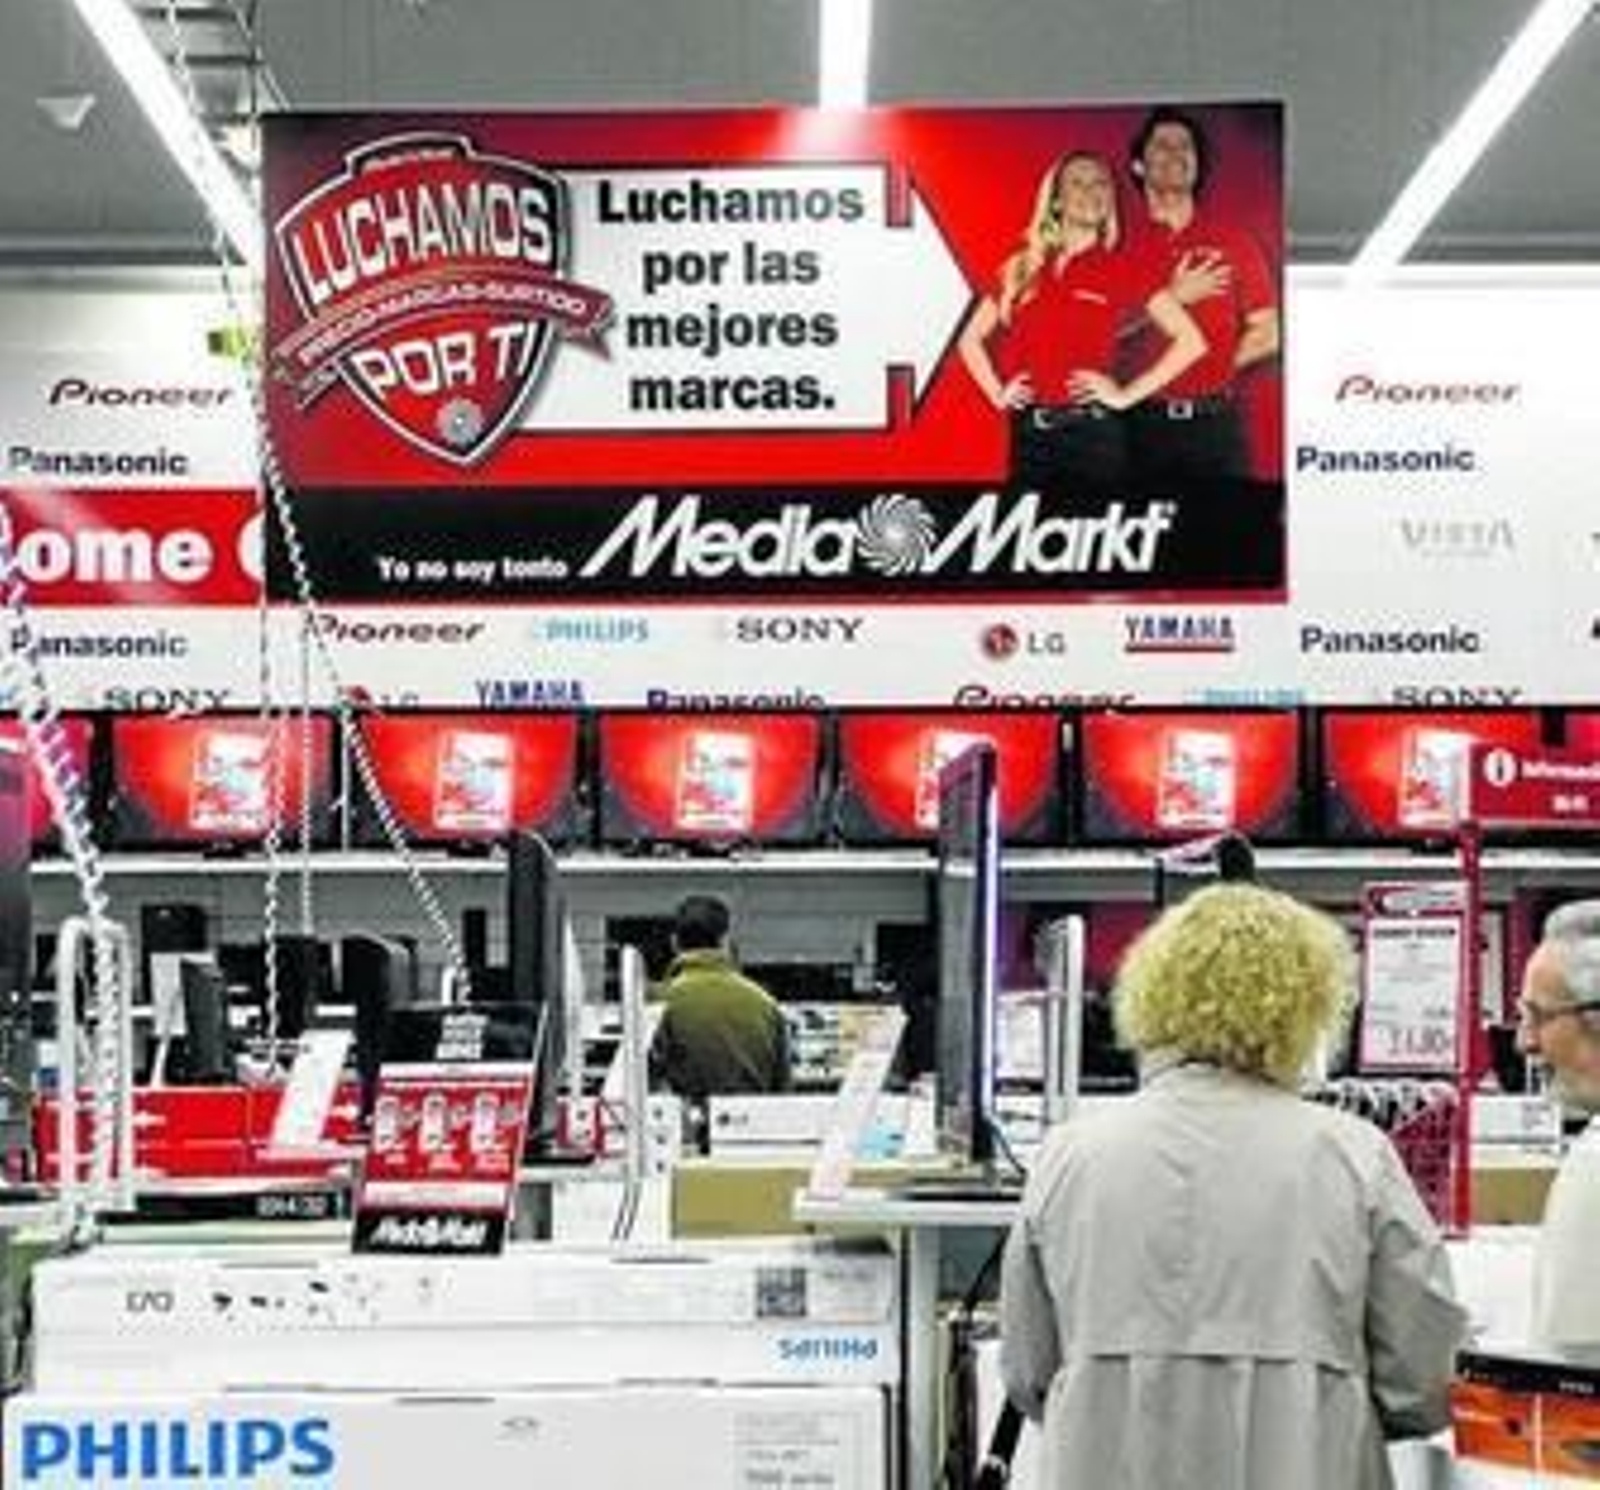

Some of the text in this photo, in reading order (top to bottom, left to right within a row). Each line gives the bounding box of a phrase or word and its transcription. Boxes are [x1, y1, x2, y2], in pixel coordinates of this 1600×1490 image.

[598, 179, 865, 223] Luchamos
[294, 184, 549, 304] LUCHAMOS
[642, 241, 820, 295] por las
[626, 303, 839, 357] mejores
[350, 320, 538, 398] POR TI
[50, 378, 233, 406] Pioneer
[629, 374, 837, 410] marcas.
[1335, 374, 1521, 402] Pioneer
[8, 446, 188, 476] Panasonic
[1296, 444, 1476, 473] Panasonic
[579, 494, 1172, 578] Media Markt
[378, 557, 409, 580] Yo
[416, 561, 447, 580] no
[303, 613, 486, 644] Pioneer
[545, 616, 651, 642] PHILIPS
[736, 615, 863, 643] SONY
[1124, 615, 1235, 639] YAMAHA
[1300, 622, 1480, 653] Panasonic
[1028, 633, 1066, 654] LG
[22, 1419, 335, 1480] PHILIPS
